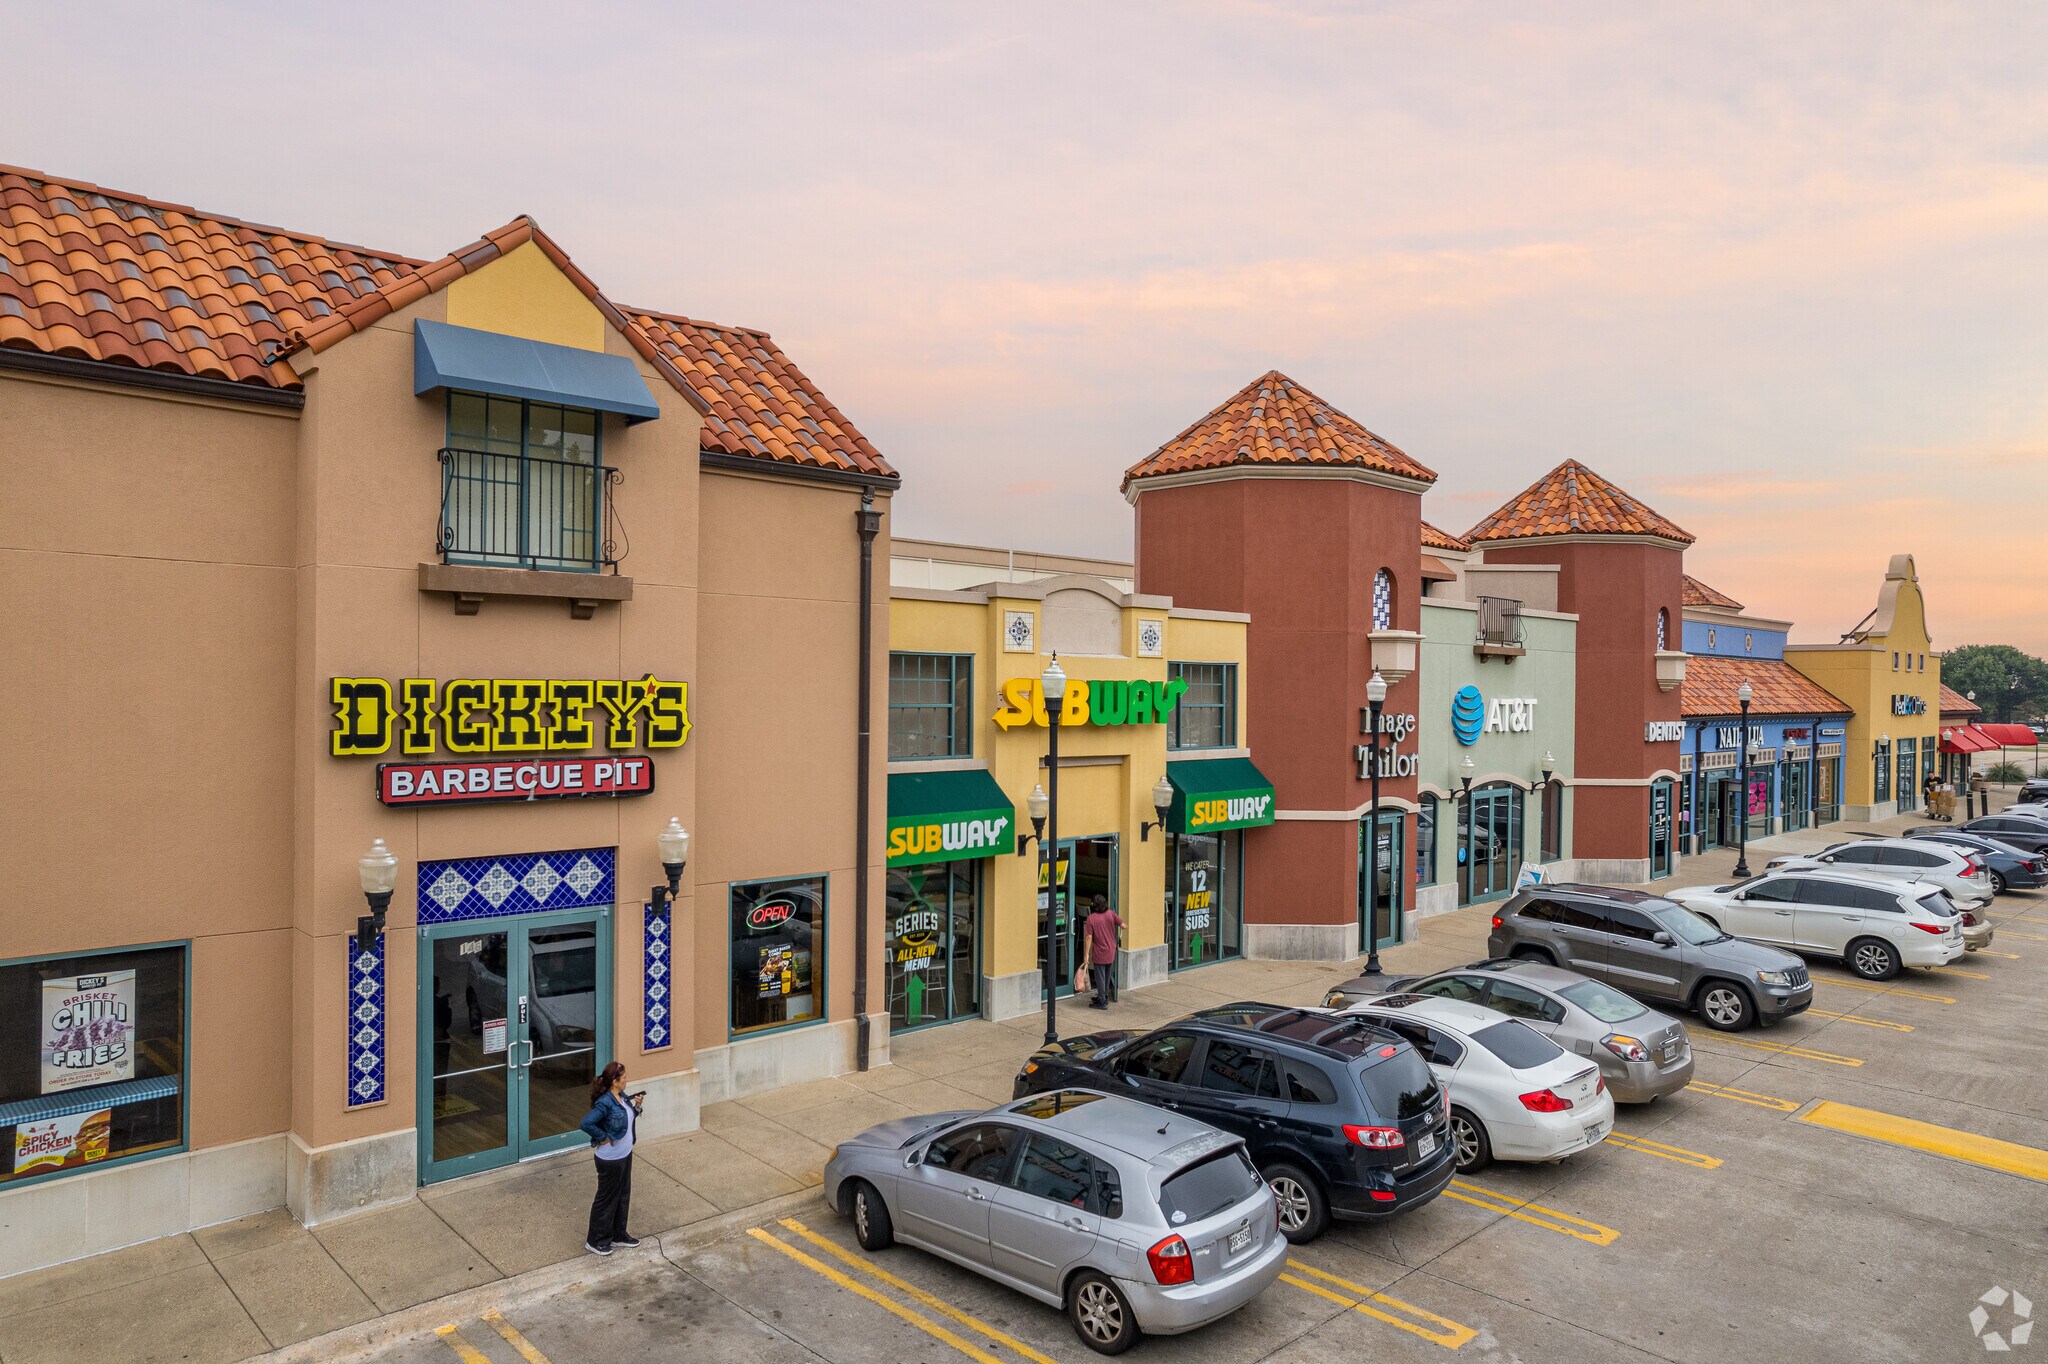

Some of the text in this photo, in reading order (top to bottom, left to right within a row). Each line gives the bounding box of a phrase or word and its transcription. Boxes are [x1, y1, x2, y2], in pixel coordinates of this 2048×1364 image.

[1485, 697, 1538, 733] AT&T
[1648, 721, 1687, 741] DENTIST
[390, 761, 644, 797] BARBECUE PIT
[1190, 794, 1271, 828] SUBWAY
[886, 816, 1008, 860] SUBWAY
[1190, 869, 1207, 893] 12
[1185, 891, 1212, 911] NEW
[752, 905, 790, 924] OPEN
[895, 912, 938, 937] SERIES
[1185, 914, 1210, 931] SUBS
[461, 940, 482, 955] 146
[897, 943, 937, 963] ALL-NEW
[904, 956, 931, 972] MENU
[62, 992, 118, 1007] BRISKET
[52, 1000, 127, 1031] CHILI
[52, 1042, 127, 1069] FRIES
[48, 1077, 67, 1085] ORDER
[18, 1135, 73, 1157] CHICKEN
[22, 1130, 60, 1147] SPICY
[28, 1157, 43, 1166] ORDER
